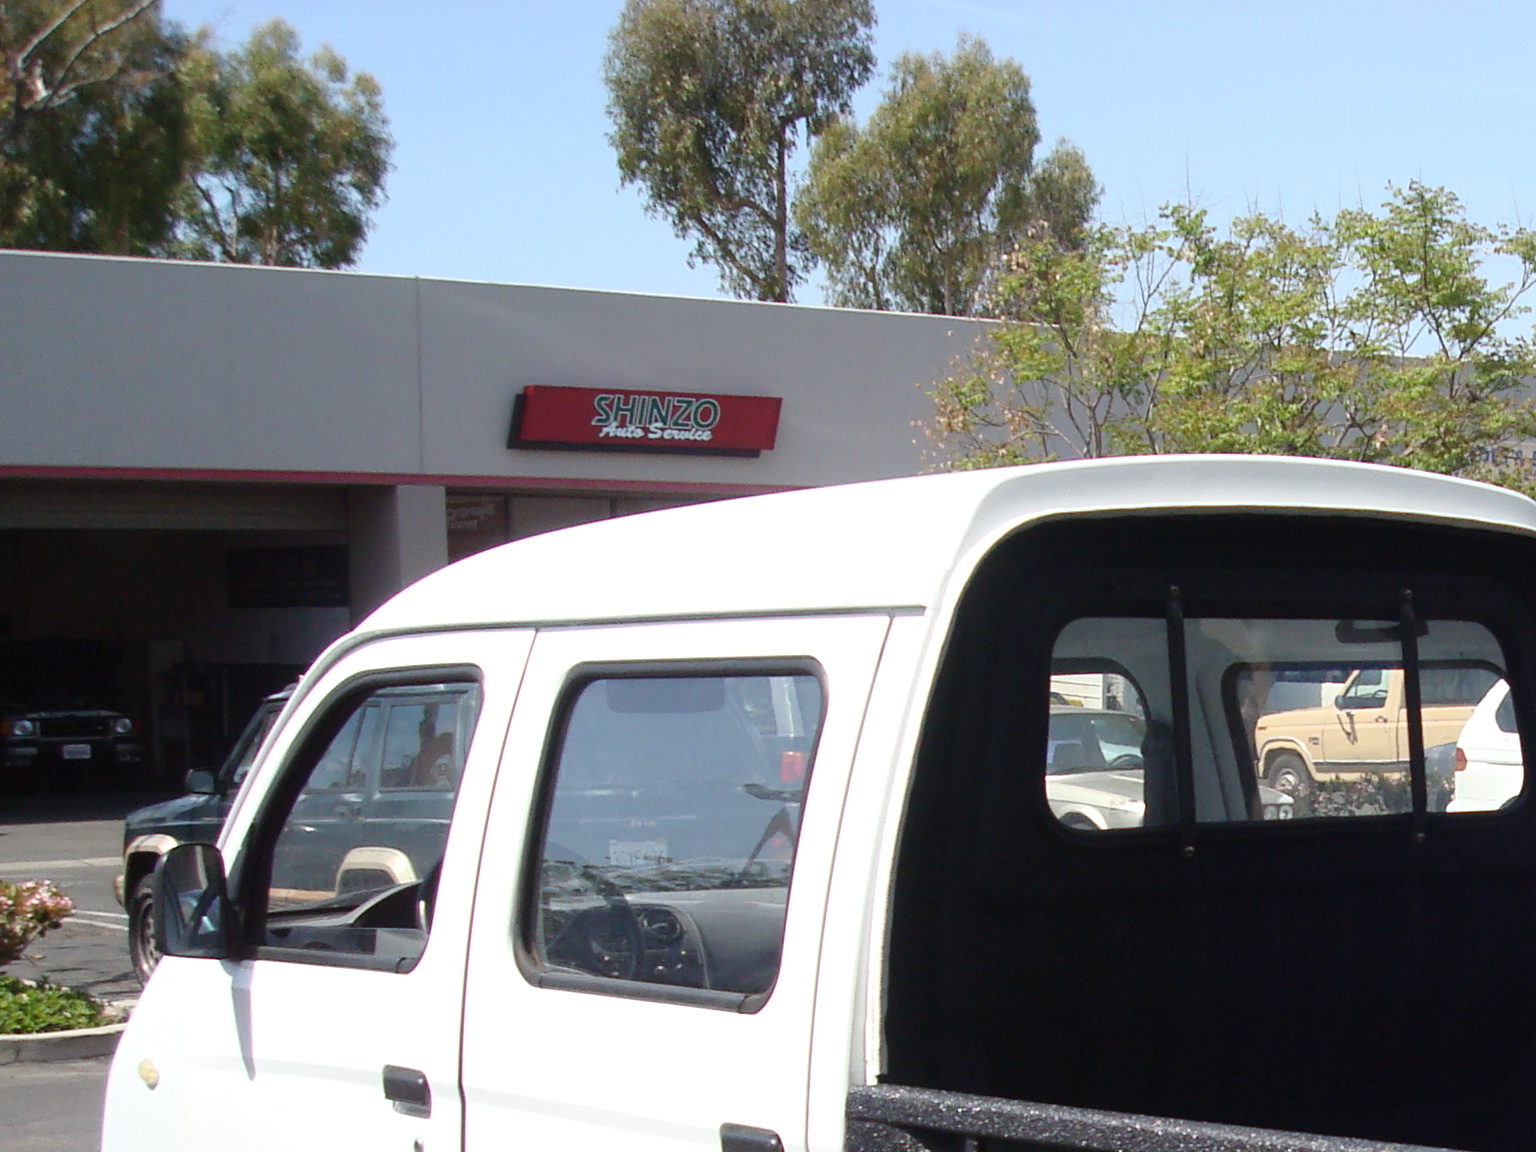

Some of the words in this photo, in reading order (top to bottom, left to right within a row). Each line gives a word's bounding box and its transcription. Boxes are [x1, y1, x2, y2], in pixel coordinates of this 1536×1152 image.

[592, 394, 721, 430] SHINZO
[599, 421, 645, 438] Auto
[647, 422, 713, 440] Service
